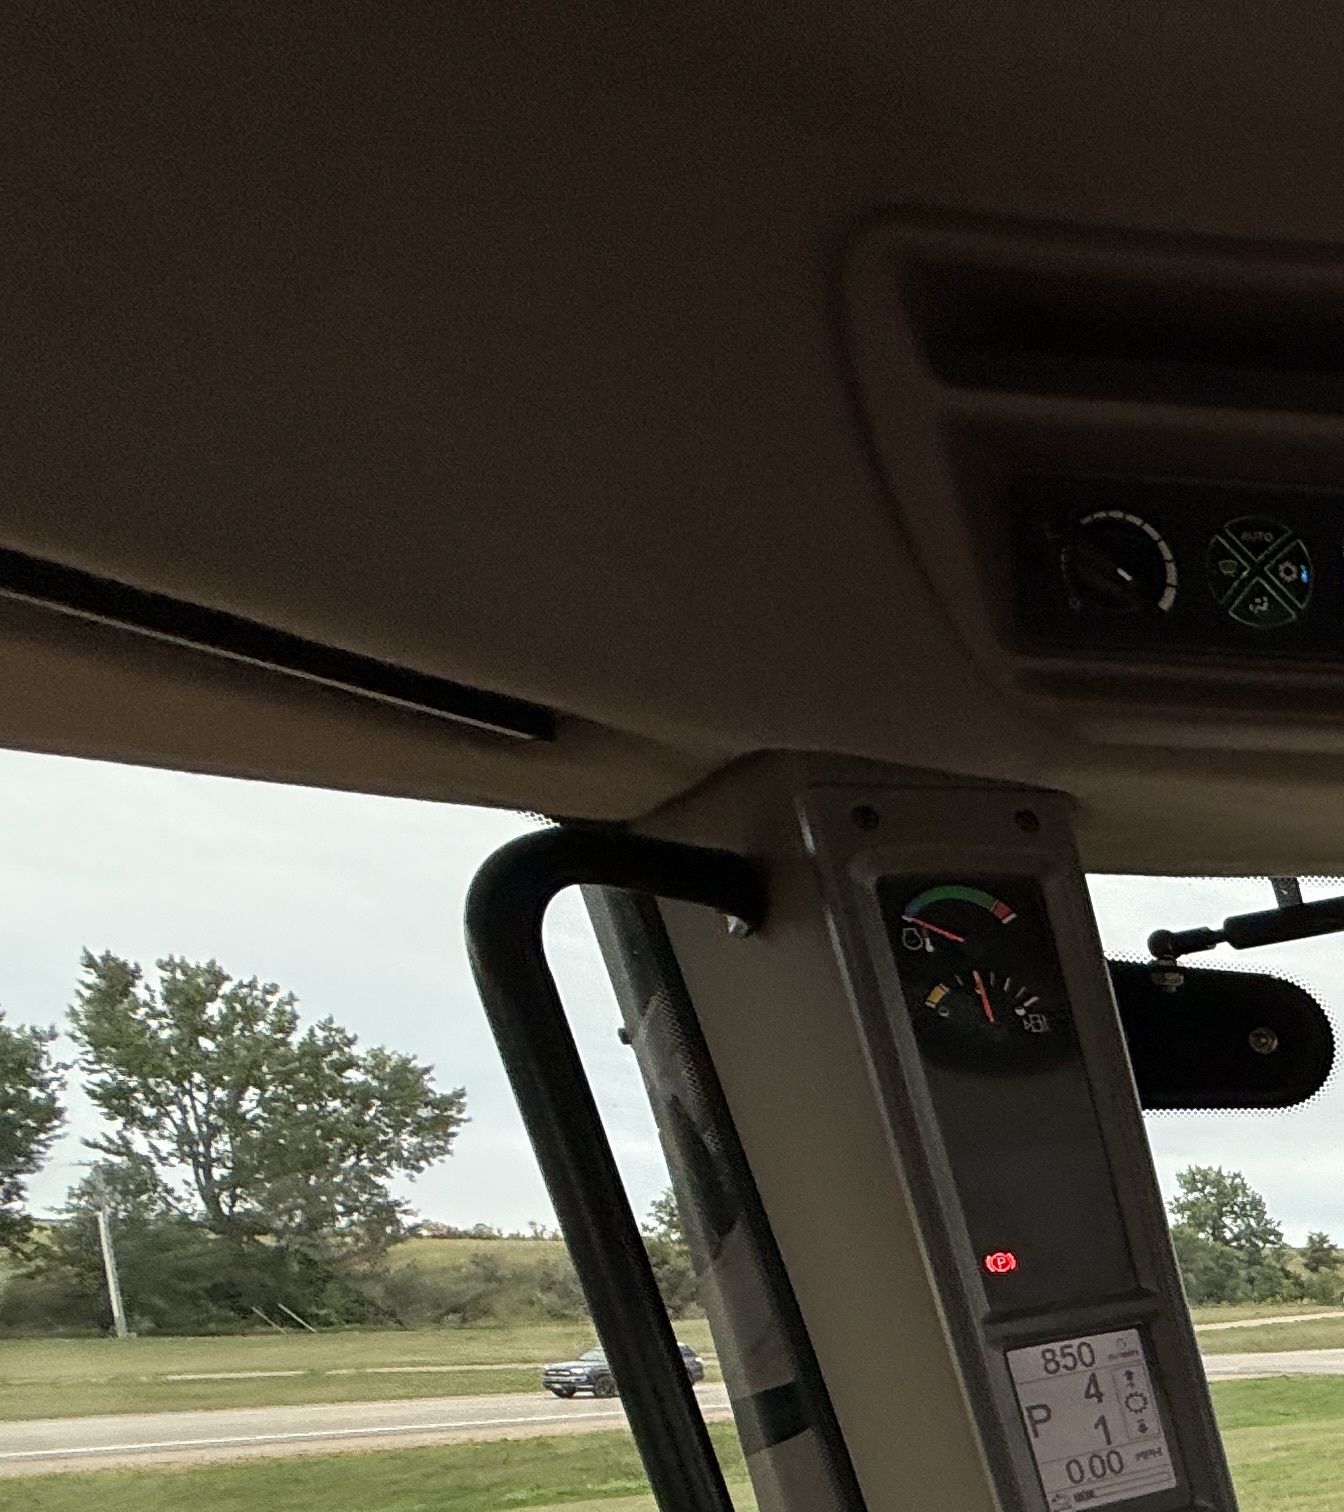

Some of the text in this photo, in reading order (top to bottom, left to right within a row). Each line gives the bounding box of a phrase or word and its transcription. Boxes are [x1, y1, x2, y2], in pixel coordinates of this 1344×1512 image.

[1241, 530, 1275, 543] AUTO
[1041, 1342, 1095, 1374] 850
[1084, 1372, 1104, 1404] 4
[1025, 1403, 1052, 1438] P
[1094, 1415, 1112, 1446] 1
[1135, 1447, 1163, 1462] MPH
